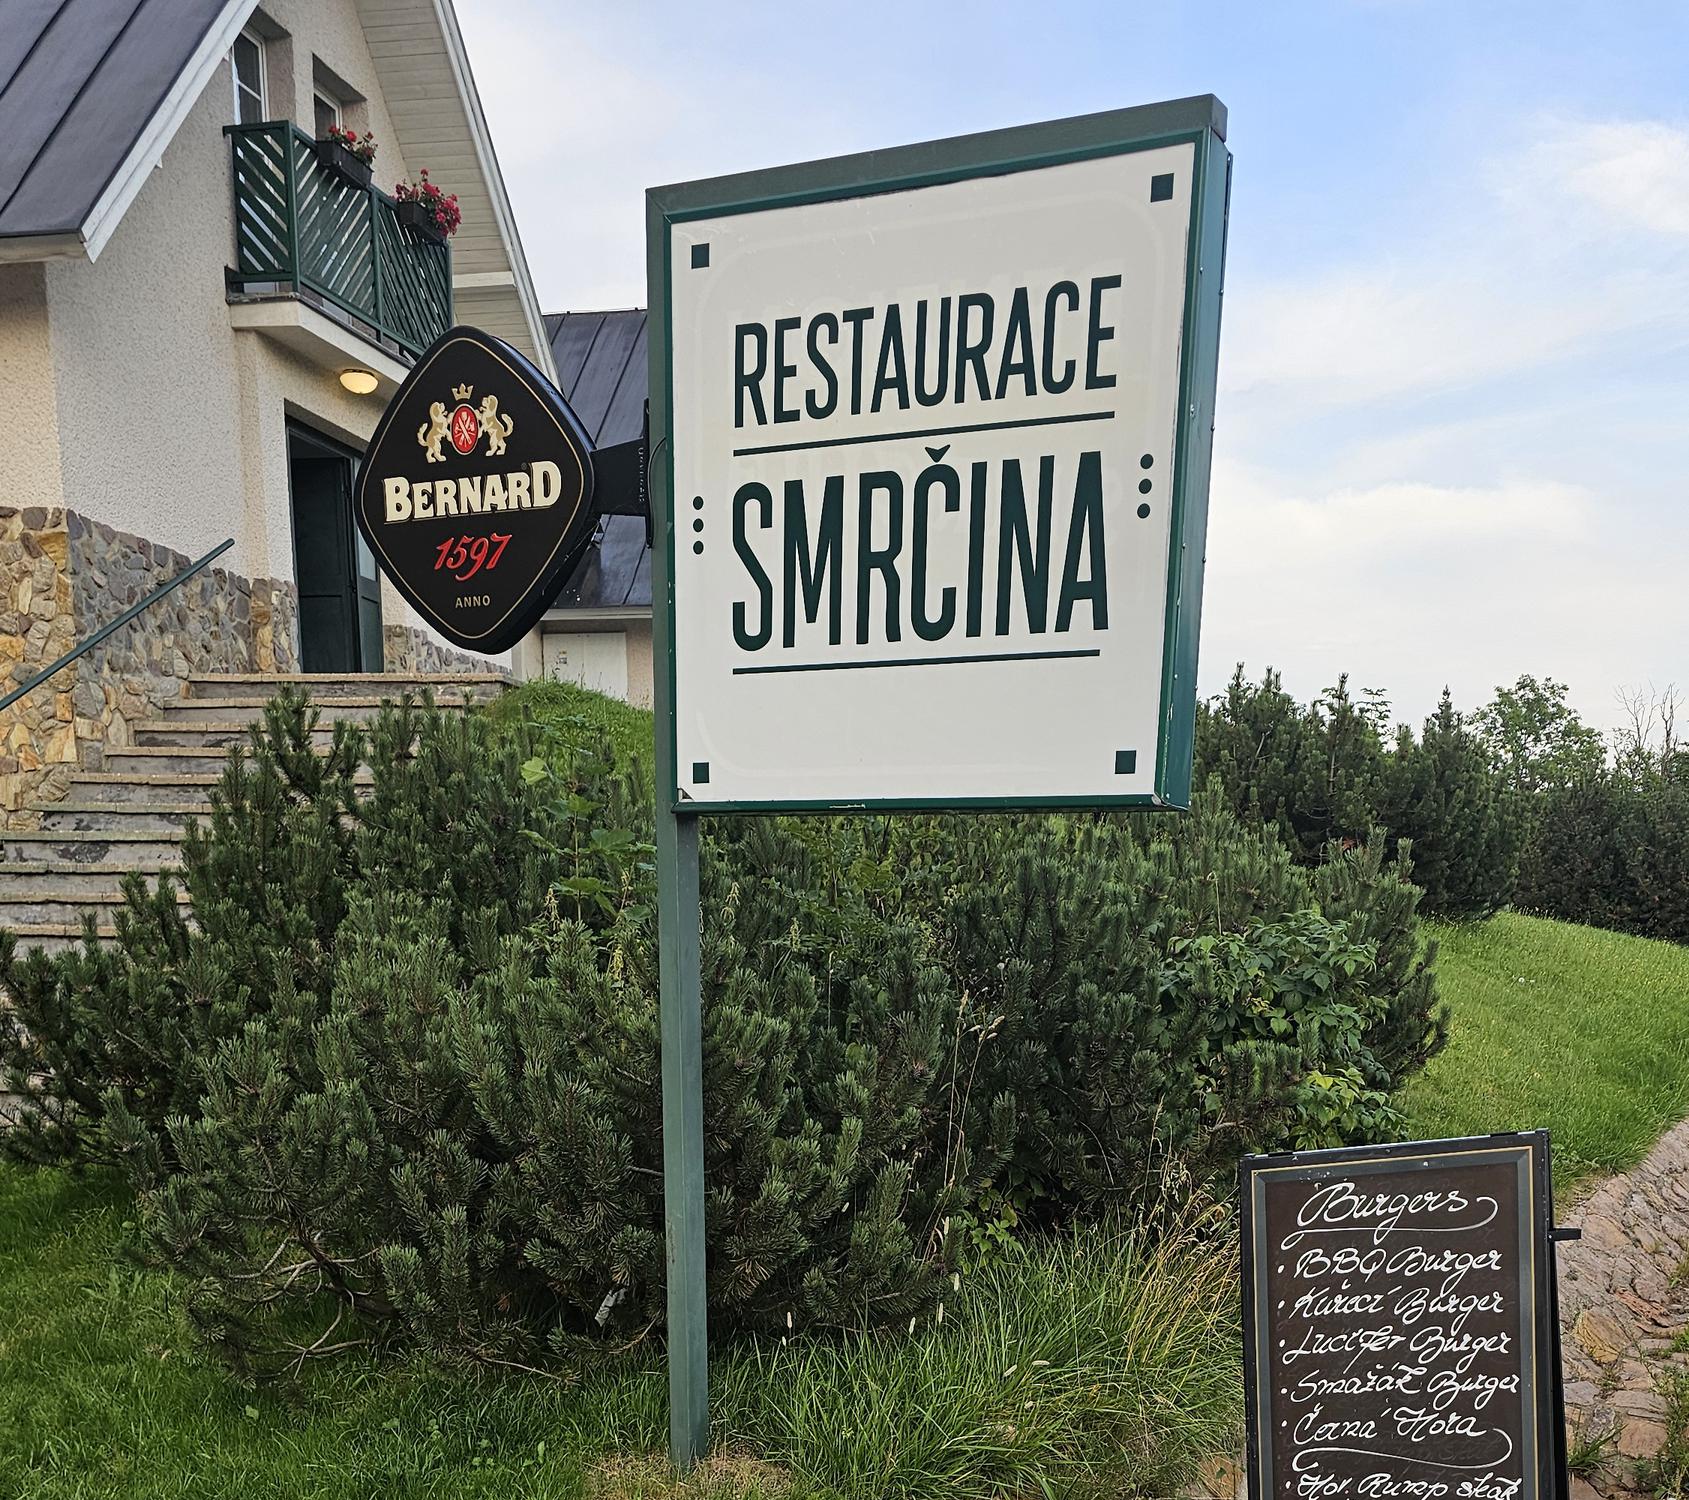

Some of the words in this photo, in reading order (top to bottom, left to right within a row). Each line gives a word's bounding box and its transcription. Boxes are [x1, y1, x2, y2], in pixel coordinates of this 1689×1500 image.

[734, 274, 1122, 429] RESTAURACE
[382, 460, 562, 522] BERNARD
[433, 532, 512, 582] 1597
[731, 444, 1109, 651] SMRČINA
[455, 595, 491, 609] ANNO
[1297, 1182, 1469, 1244] Burgers
[1294, 1248, 1386, 1282] BBQ
[1386, 1246, 1502, 1297] Burger
[1289, 1278, 1399, 1319] Kuřecí
[1394, 1287, 1504, 1335] Burger
[1409, 1326, 1512, 1373] Burger
[1291, 1362, 1427, 1403] Smažák
[1424, 1370, 1520, 1410] Burger
[1293, 1404, 1391, 1445] Černá
[1393, 1406, 1486, 1442] Hora
